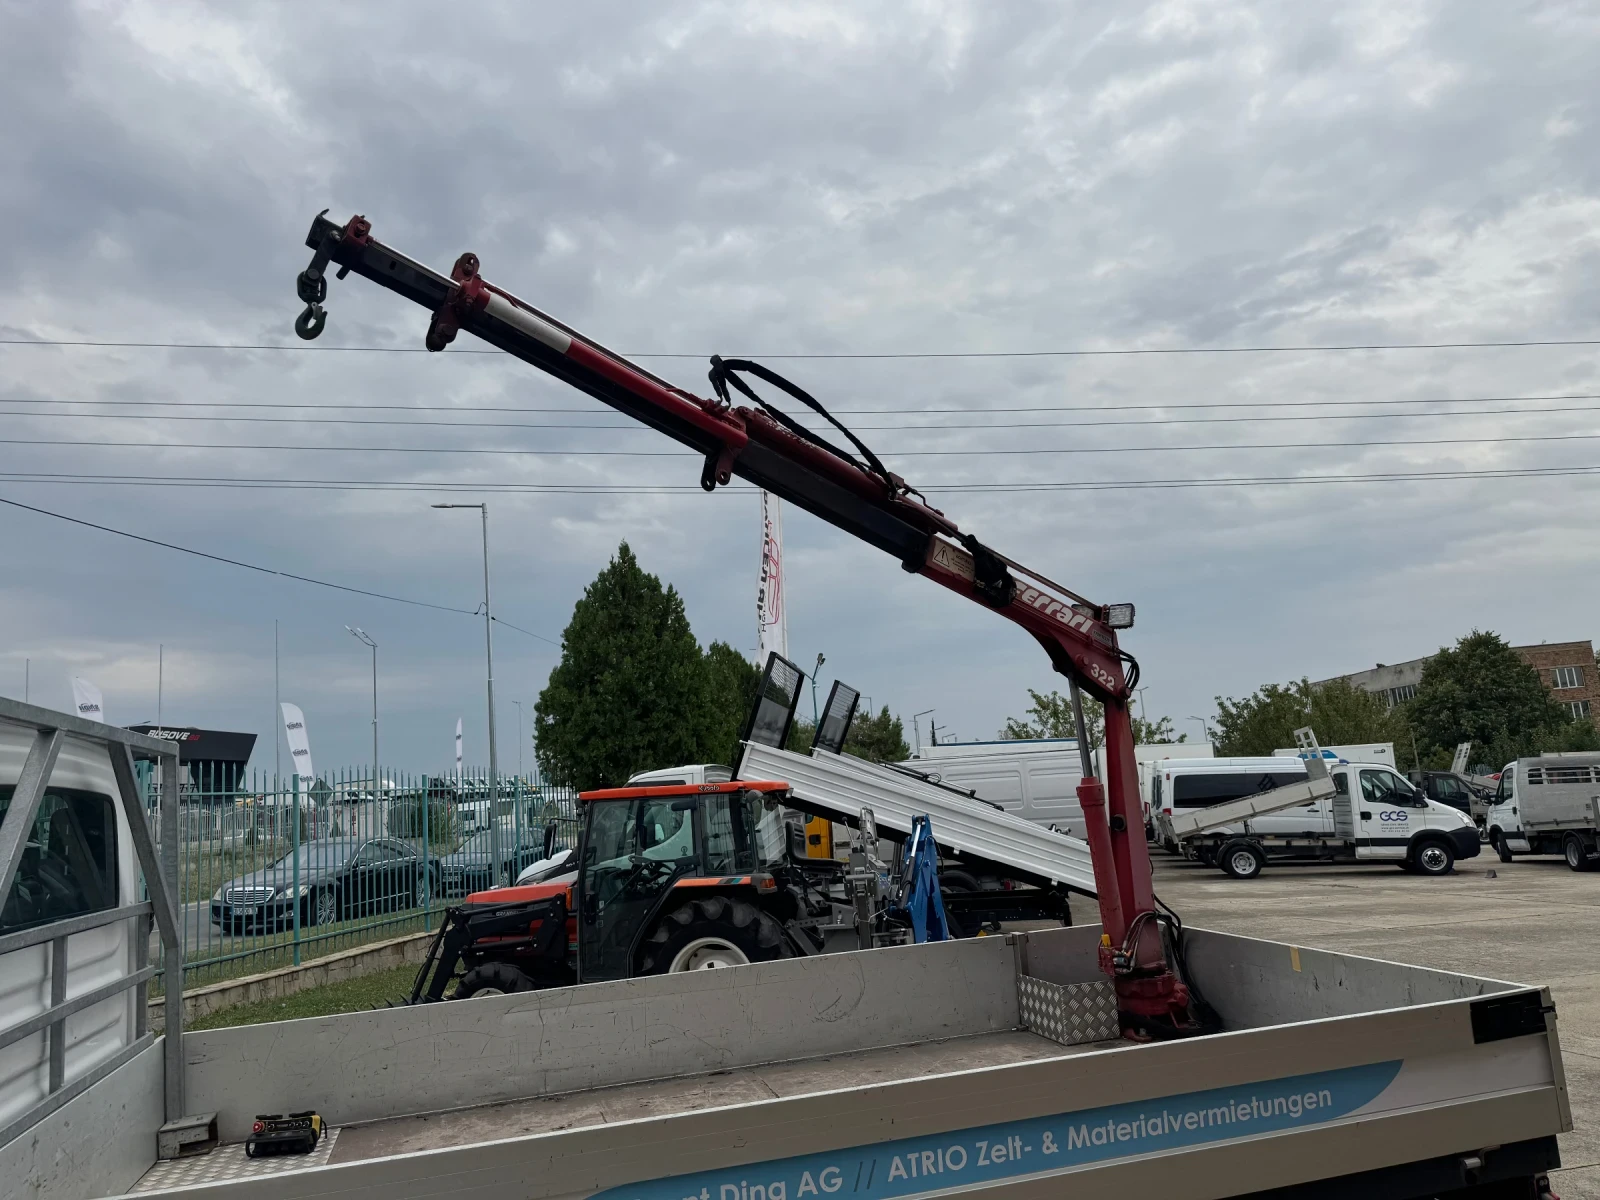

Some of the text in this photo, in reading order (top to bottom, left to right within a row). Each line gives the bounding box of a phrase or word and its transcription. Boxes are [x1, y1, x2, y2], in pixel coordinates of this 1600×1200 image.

[1091, 664, 1115, 691] 322
[1380, 811, 1408, 821] GCS
[796, 1165, 843, 1198] AG
[887, 1145, 968, 1183] ATRIO
[976, 1135, 1032, 1167] Zelt-
[1041, 1131, 1059, 1155] &
[1067, 1088, 1332, 1151] Materialvermietungen
